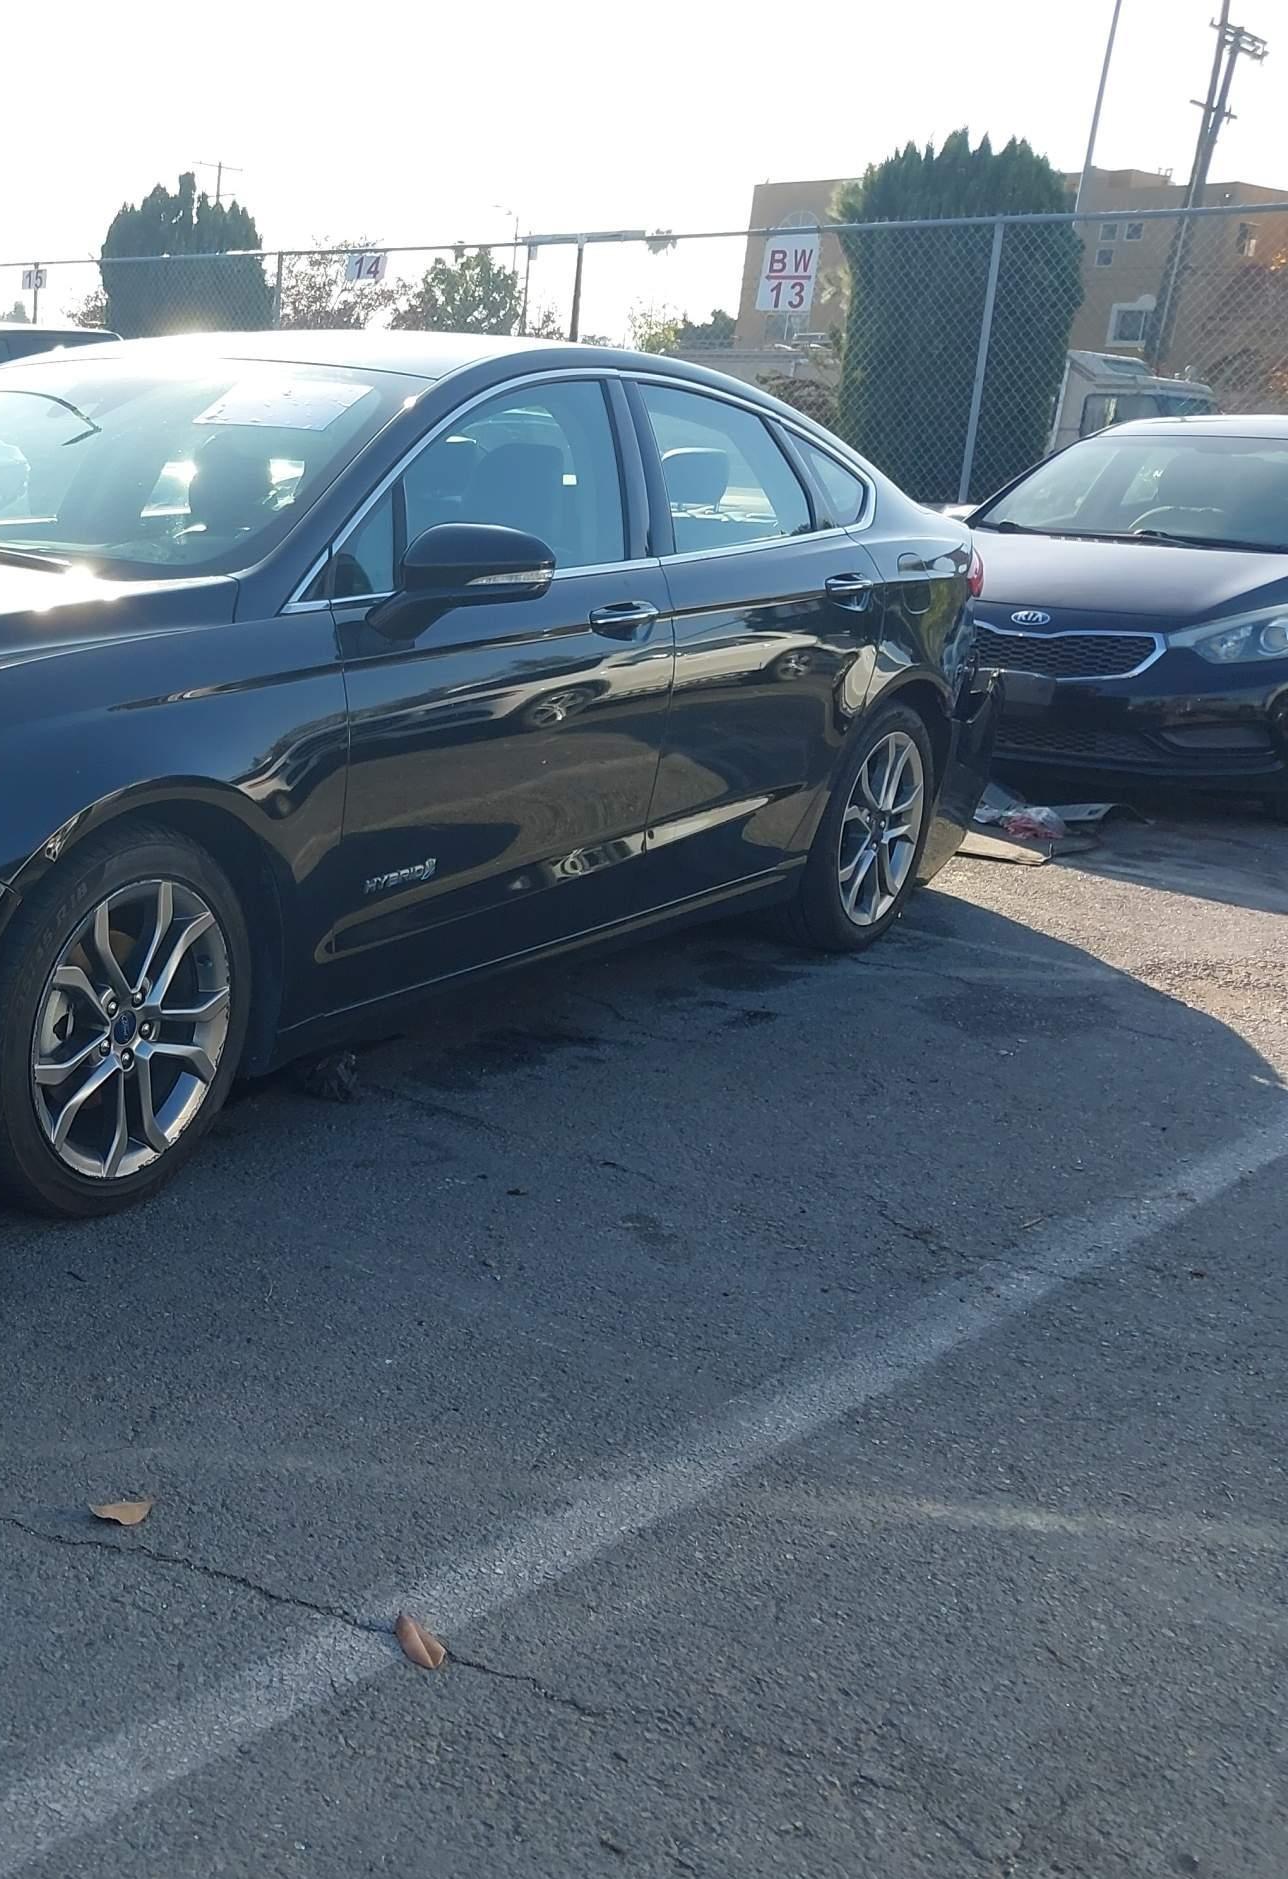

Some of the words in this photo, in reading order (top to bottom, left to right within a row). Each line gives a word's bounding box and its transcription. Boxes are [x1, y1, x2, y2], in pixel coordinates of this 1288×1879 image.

[354, 255, 380, 279] 14
[769, 249, 813, 273] BW
[25, 271, 43, 288] 15
[770, 281, 804, 308] 13
[364, 864, 425, 894] HYBRID
